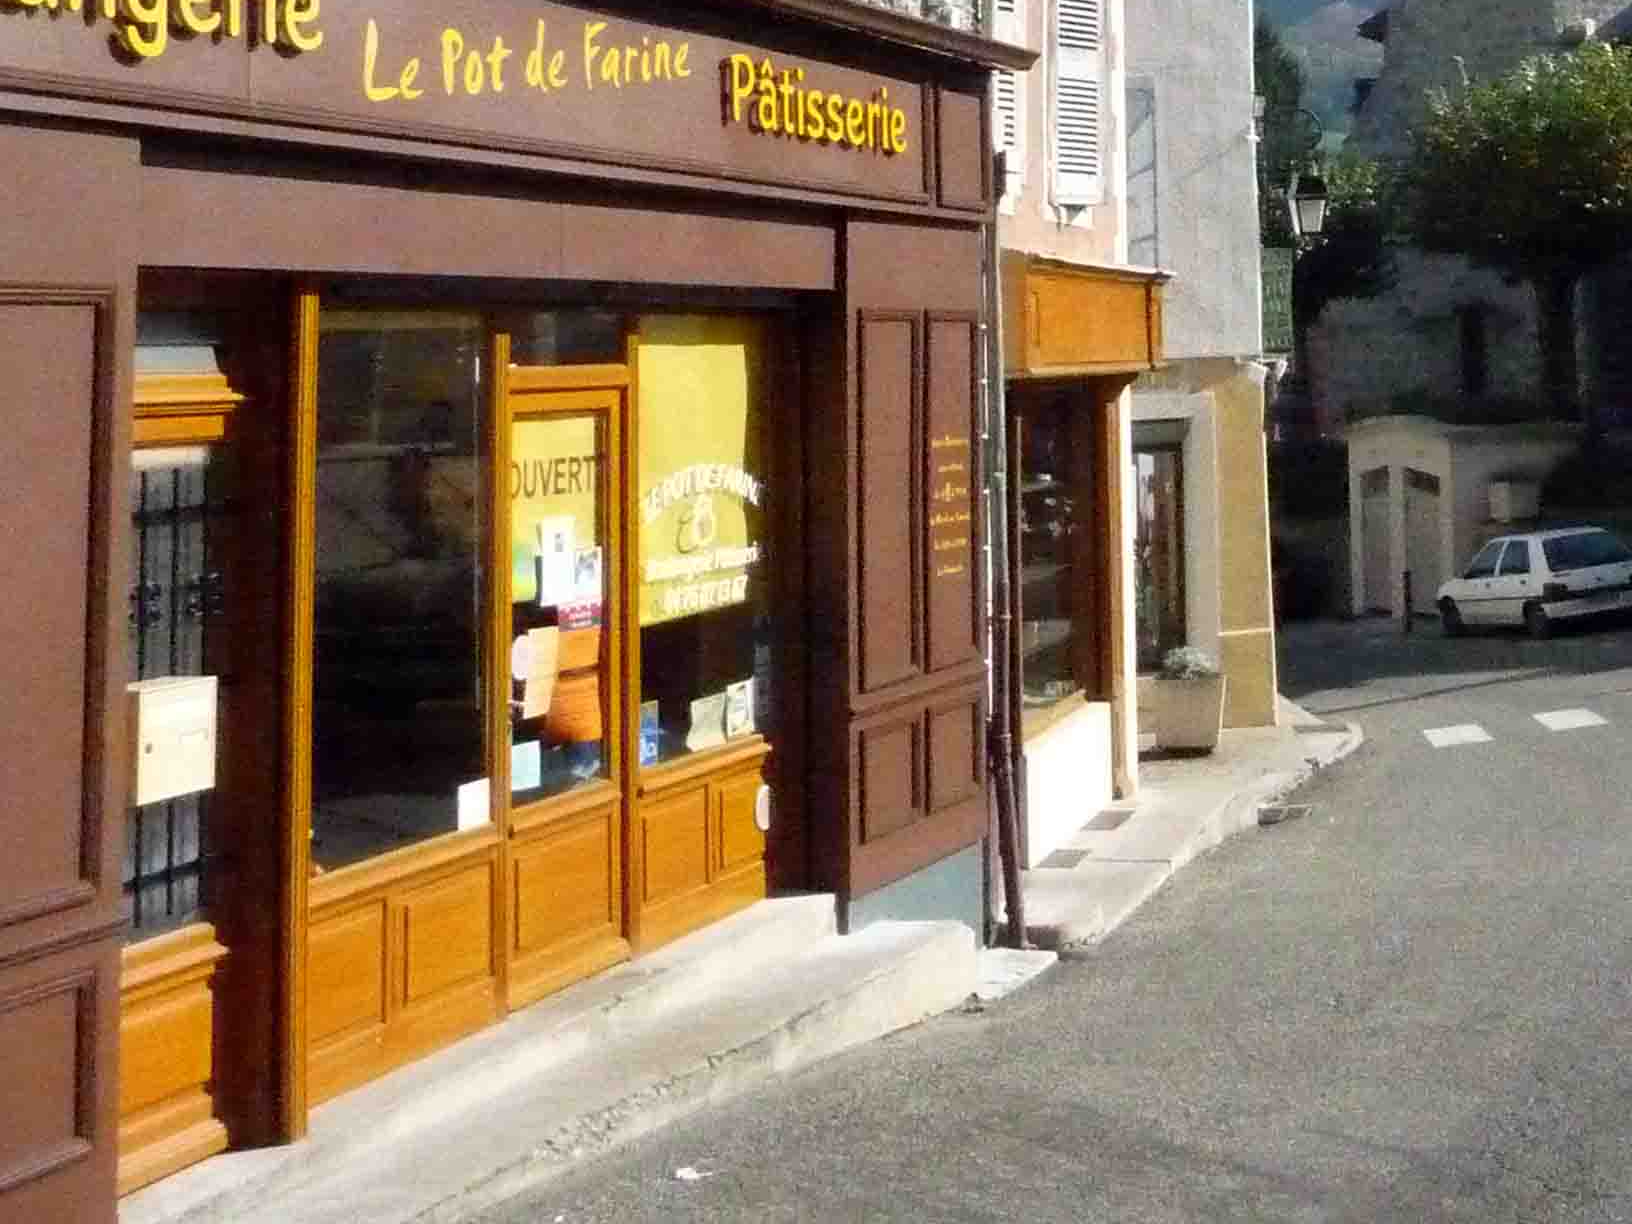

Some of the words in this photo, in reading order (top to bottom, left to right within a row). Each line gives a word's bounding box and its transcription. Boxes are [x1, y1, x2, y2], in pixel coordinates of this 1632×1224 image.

[363, 18, 424, 101] Le
[440, 28, 512, 96] Pot
[525, 18, 568, 93] de
[584, 22, 692, 91] Farine
[731, 53, 907, 153] Pâtisserie
